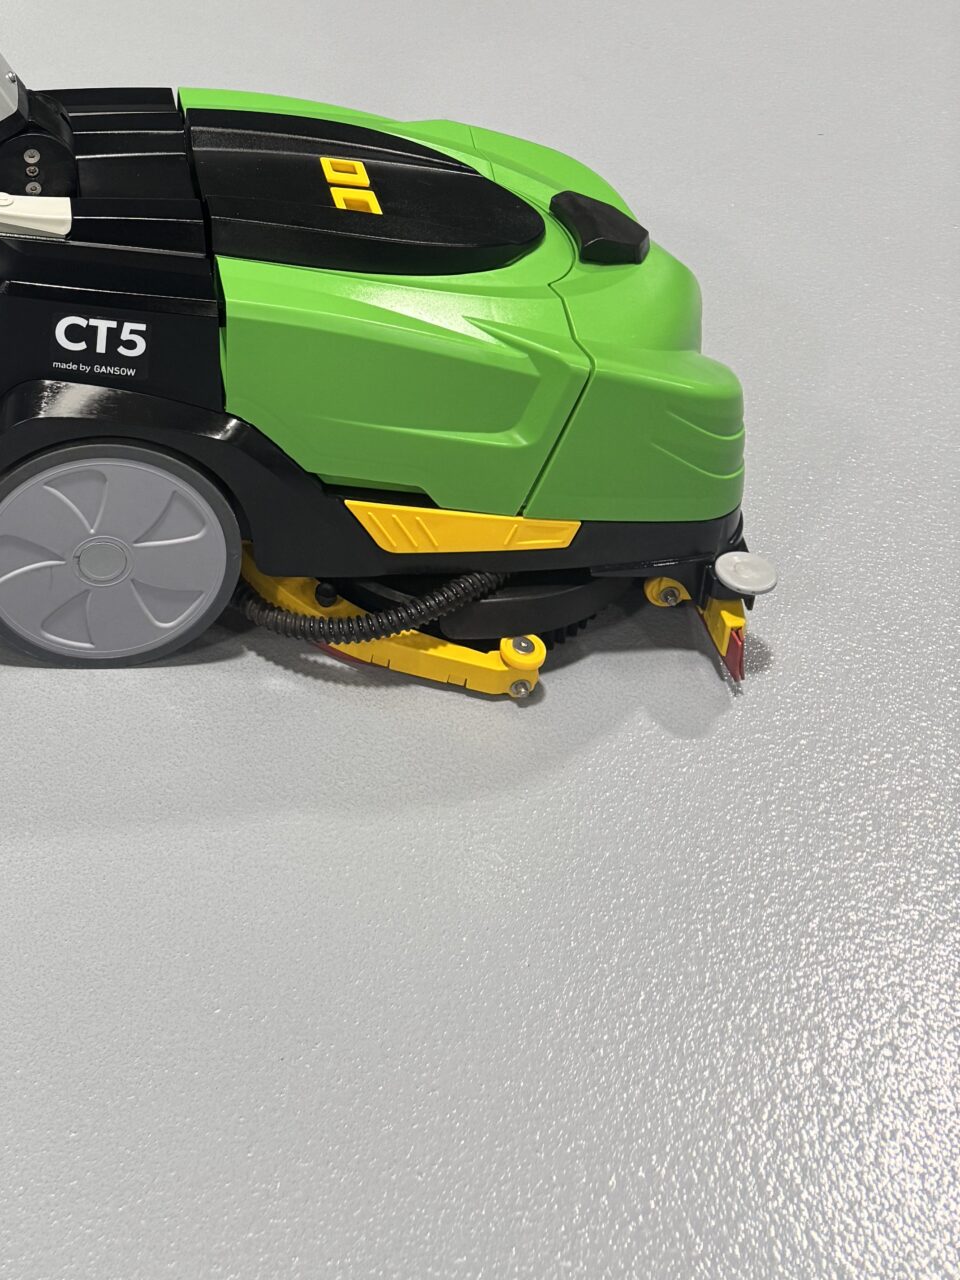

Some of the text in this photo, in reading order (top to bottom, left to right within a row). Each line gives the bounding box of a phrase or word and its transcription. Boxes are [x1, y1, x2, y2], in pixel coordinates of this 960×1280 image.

[55, 315, 147, 357] CT5
[52, 361, 136, 376] made by GANSOW
